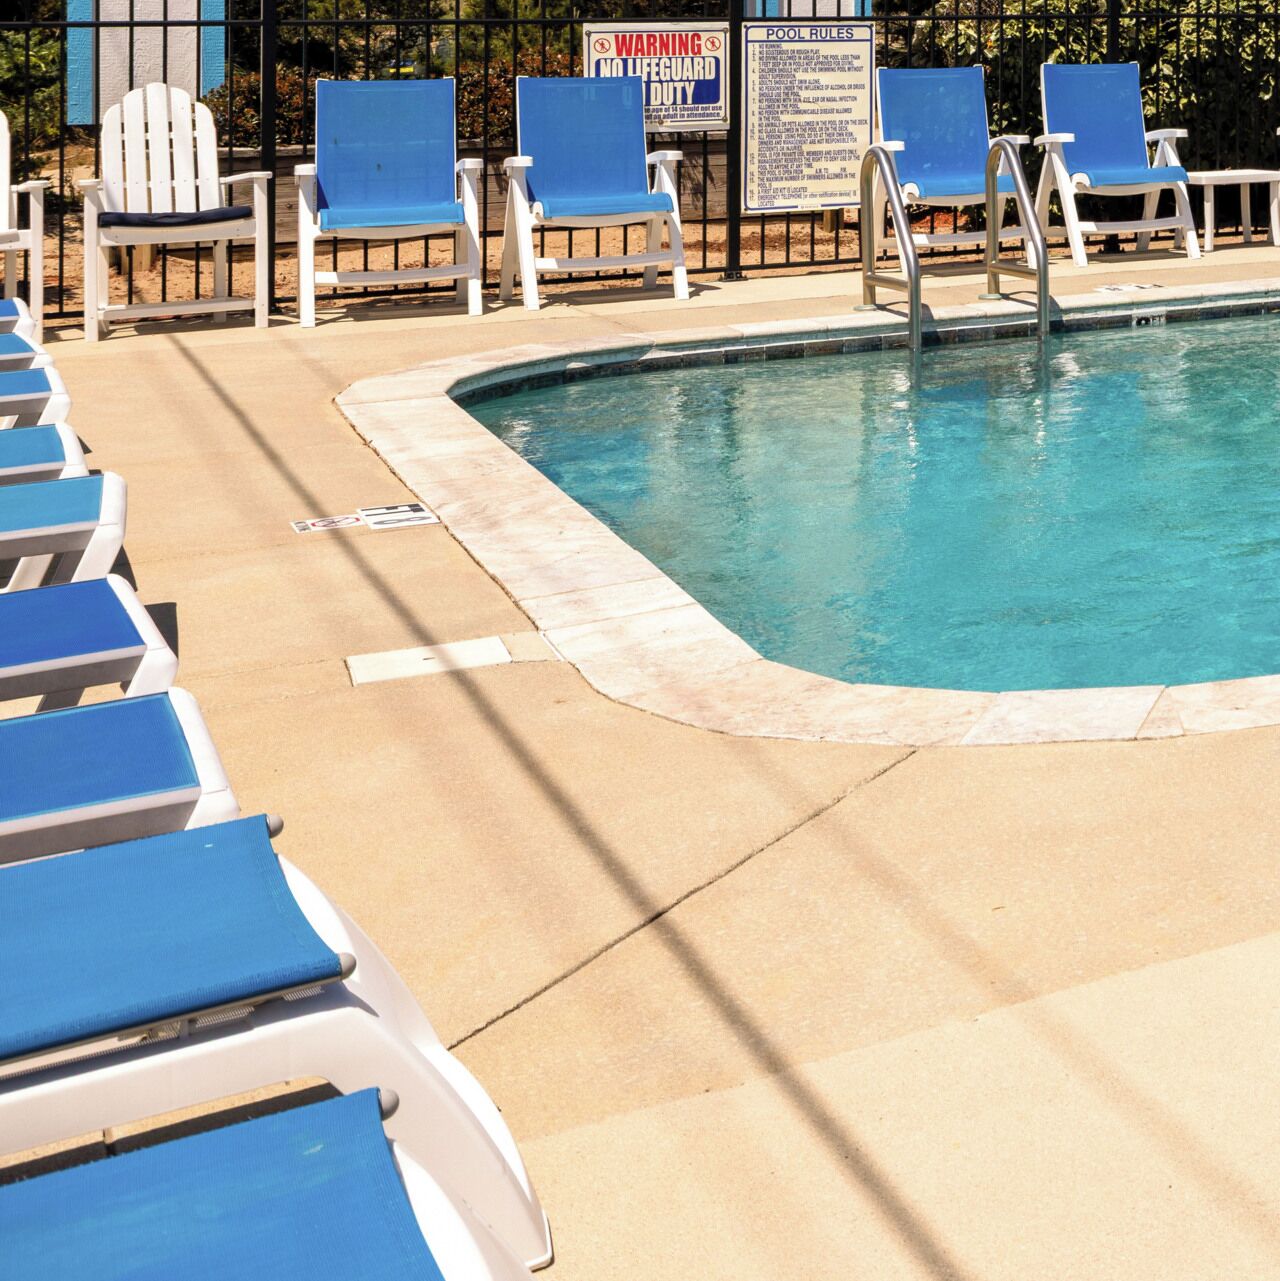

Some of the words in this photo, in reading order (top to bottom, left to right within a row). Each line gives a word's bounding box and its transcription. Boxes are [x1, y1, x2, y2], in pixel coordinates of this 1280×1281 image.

[614, 32, 702, 57] WARNING
[767, 28, 805, 40] POOL
[810, 28, 854, 39] RULES
[600, 58, 624, 78] NO
[628, 57, 716, 81] LIFEGUARD
[651, 81, 695, 106] DUTY
